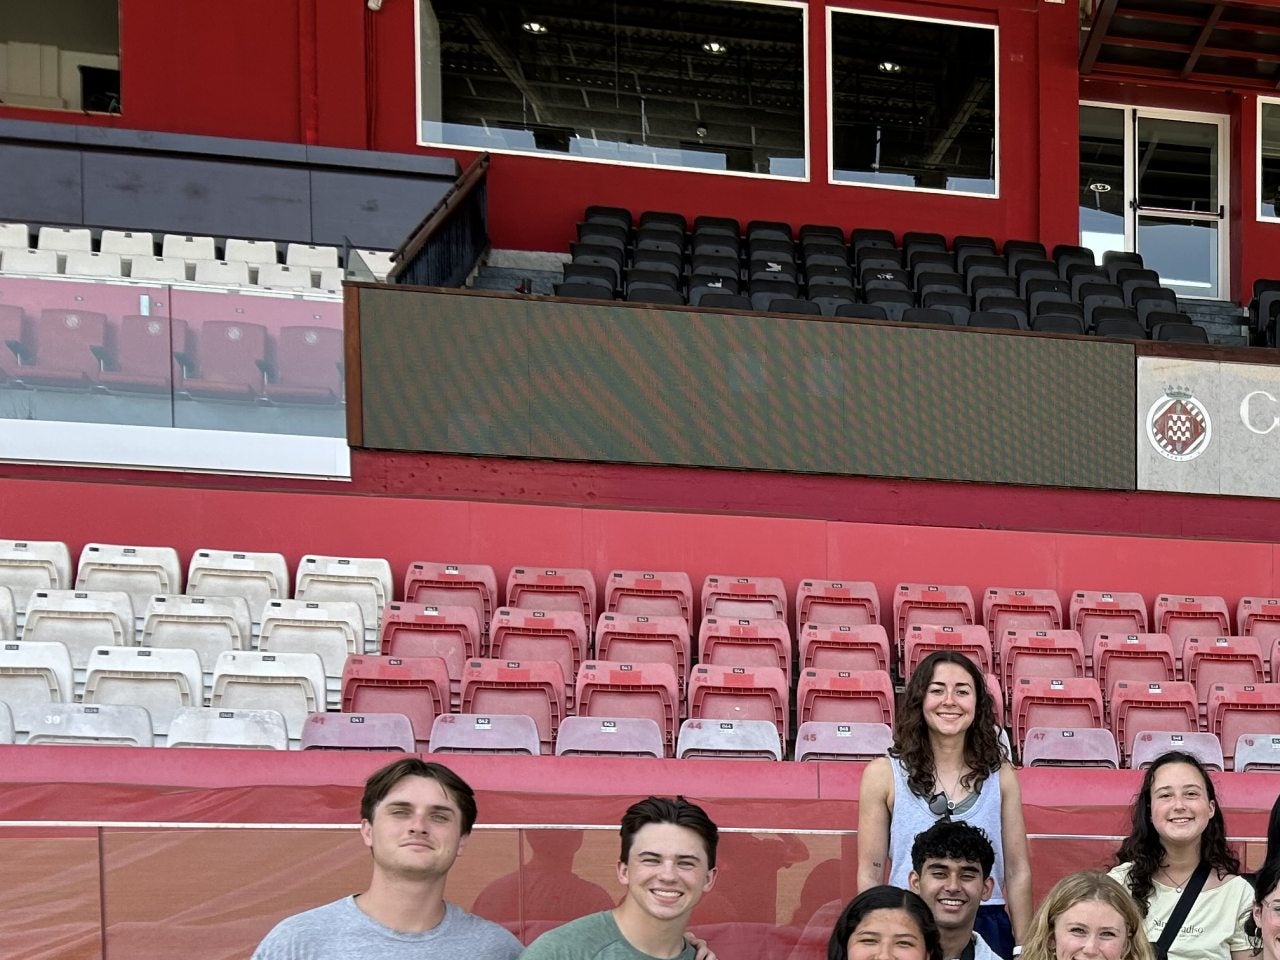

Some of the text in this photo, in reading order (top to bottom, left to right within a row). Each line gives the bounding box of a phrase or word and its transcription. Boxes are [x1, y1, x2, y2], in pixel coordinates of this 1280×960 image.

[45, 715, 60, 724] 39
[440, 716, 455, 724] 42
[803, 734, 816, 742] 45
[1033, 733, 1046, 741] 47
